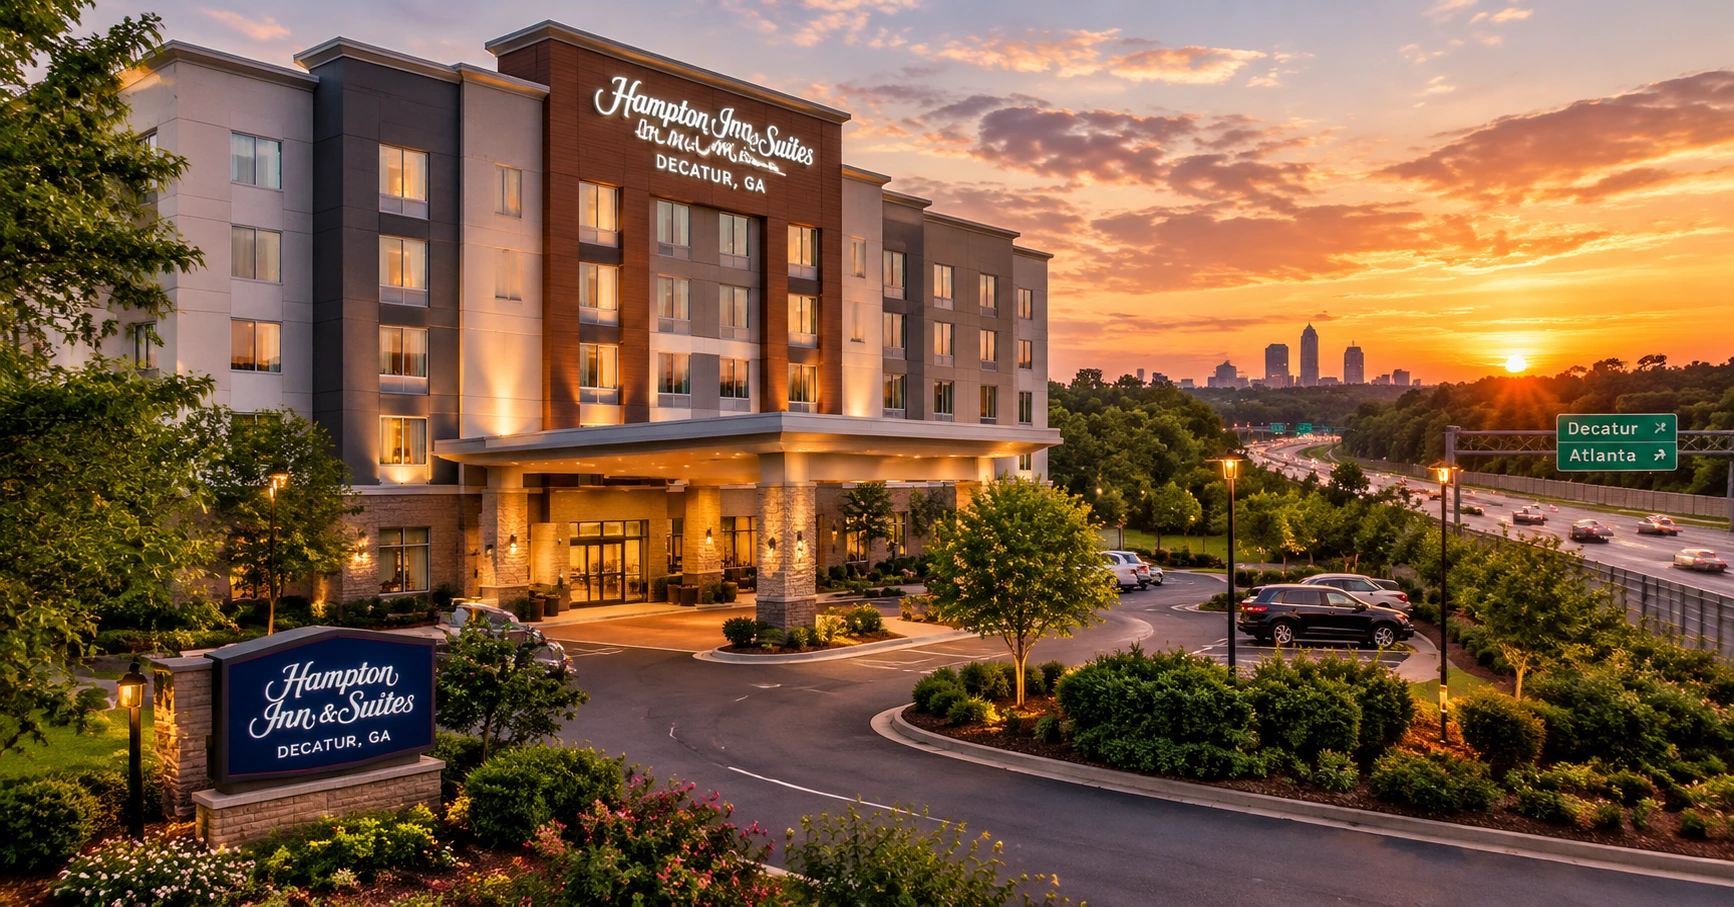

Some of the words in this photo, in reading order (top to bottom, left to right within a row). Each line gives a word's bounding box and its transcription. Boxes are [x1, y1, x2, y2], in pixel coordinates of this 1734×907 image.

[594, 76, 709, 135] Hampton
[711, 107, 753, 143] Inn
[758, 125, 814, 166] Suites
[656, 153, 739, 190] DECATUR,
[744, 175, 766, 194] GA
[1568, 421, 1639, 436] Decatur
[1569, 448, 1637, 462] Atlanta
[265, 660, 399, 703] Hampton
[249, 700, 316, 739] Inn
[319, 703, 339, 724] &
[337, 690, 415, 724] Suites
[277, 734, 363, 759] DECATUR,
[368, 729, 391, 744] GA
